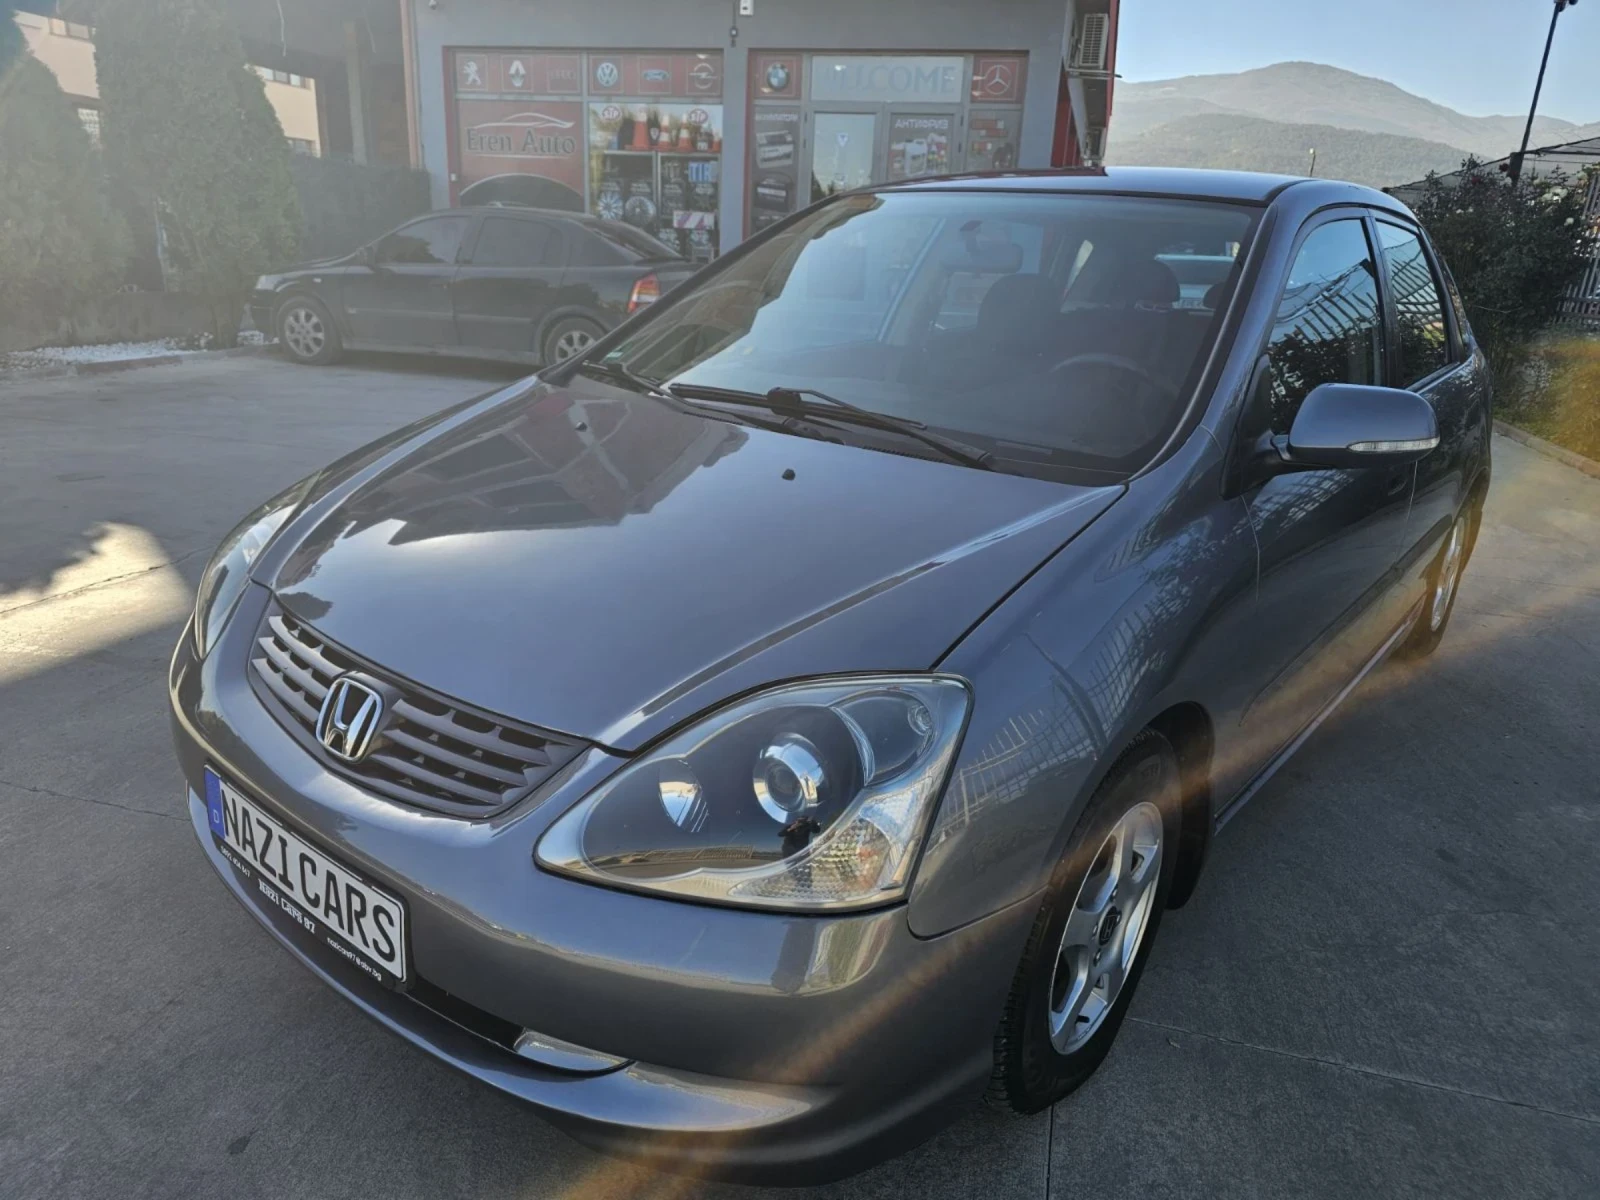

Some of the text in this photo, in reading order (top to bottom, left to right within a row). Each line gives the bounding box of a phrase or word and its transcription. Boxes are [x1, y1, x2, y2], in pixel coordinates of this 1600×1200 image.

[466, 128, 576, 155] Eren Auto
[213, 809, 219, 824] D
[221, 789, 396, 963] NAZI CARS
